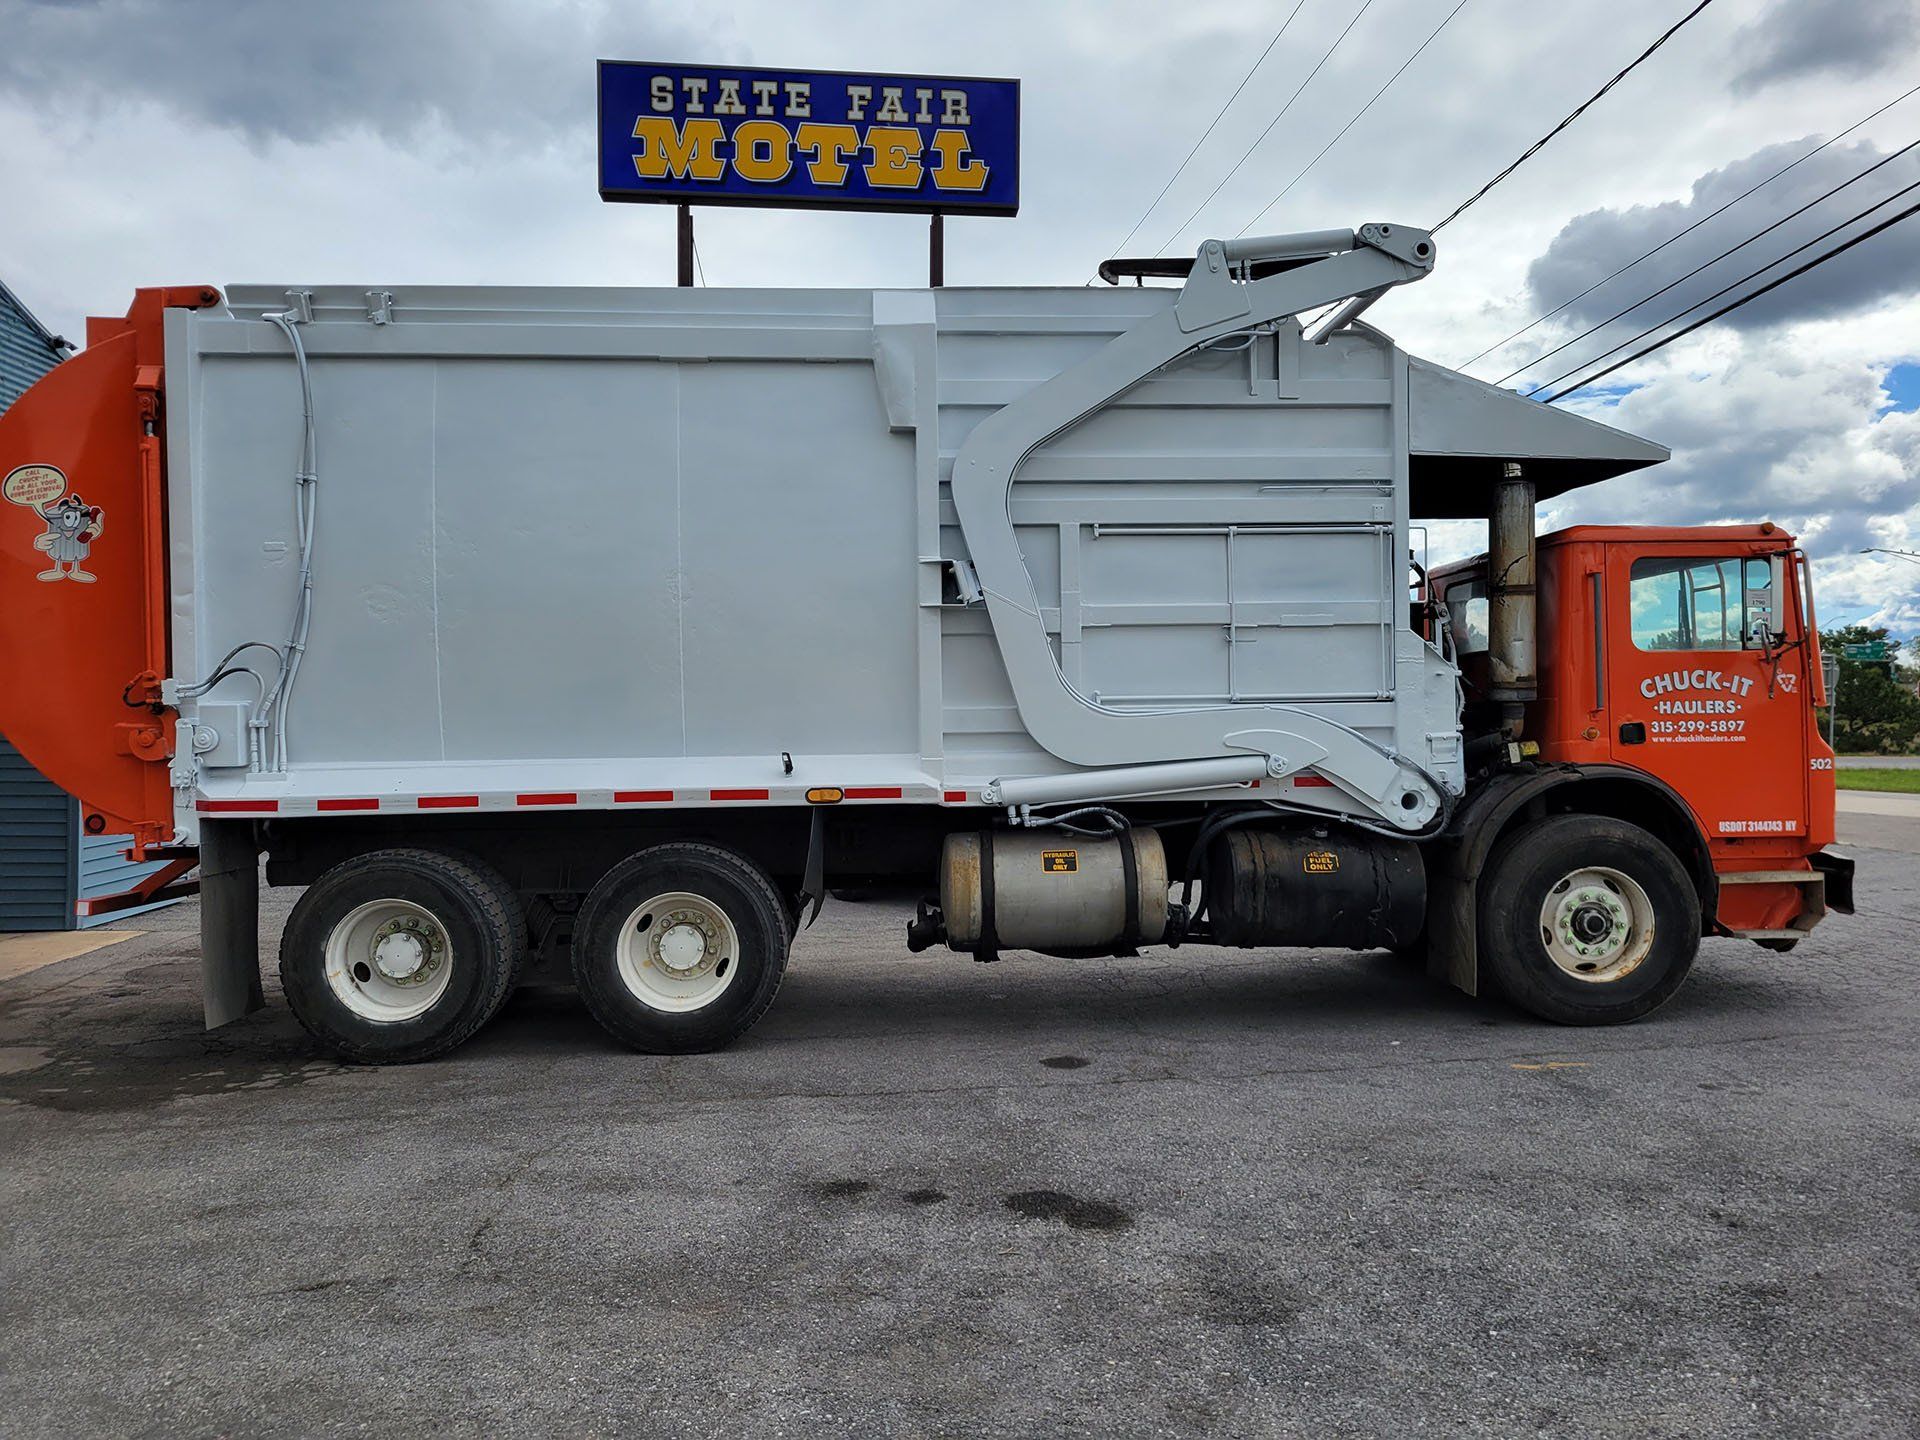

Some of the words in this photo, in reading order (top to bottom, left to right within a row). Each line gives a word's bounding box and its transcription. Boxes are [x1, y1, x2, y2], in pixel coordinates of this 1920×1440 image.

[650, 75, 811, 118] STATE
[846, 84, 971, 126] FAIR
[631, 115, 990, 191] MOTEL
[1640, 669, 1754, 698] CHUCK-IT
[1651, 734, 1746, 743] www.chuckithaulers.com
[1810, 758, 1832, 770] 502
[1719, 820, 1747, 832] USDOT
[1785, 820, 1797, 831] NY
